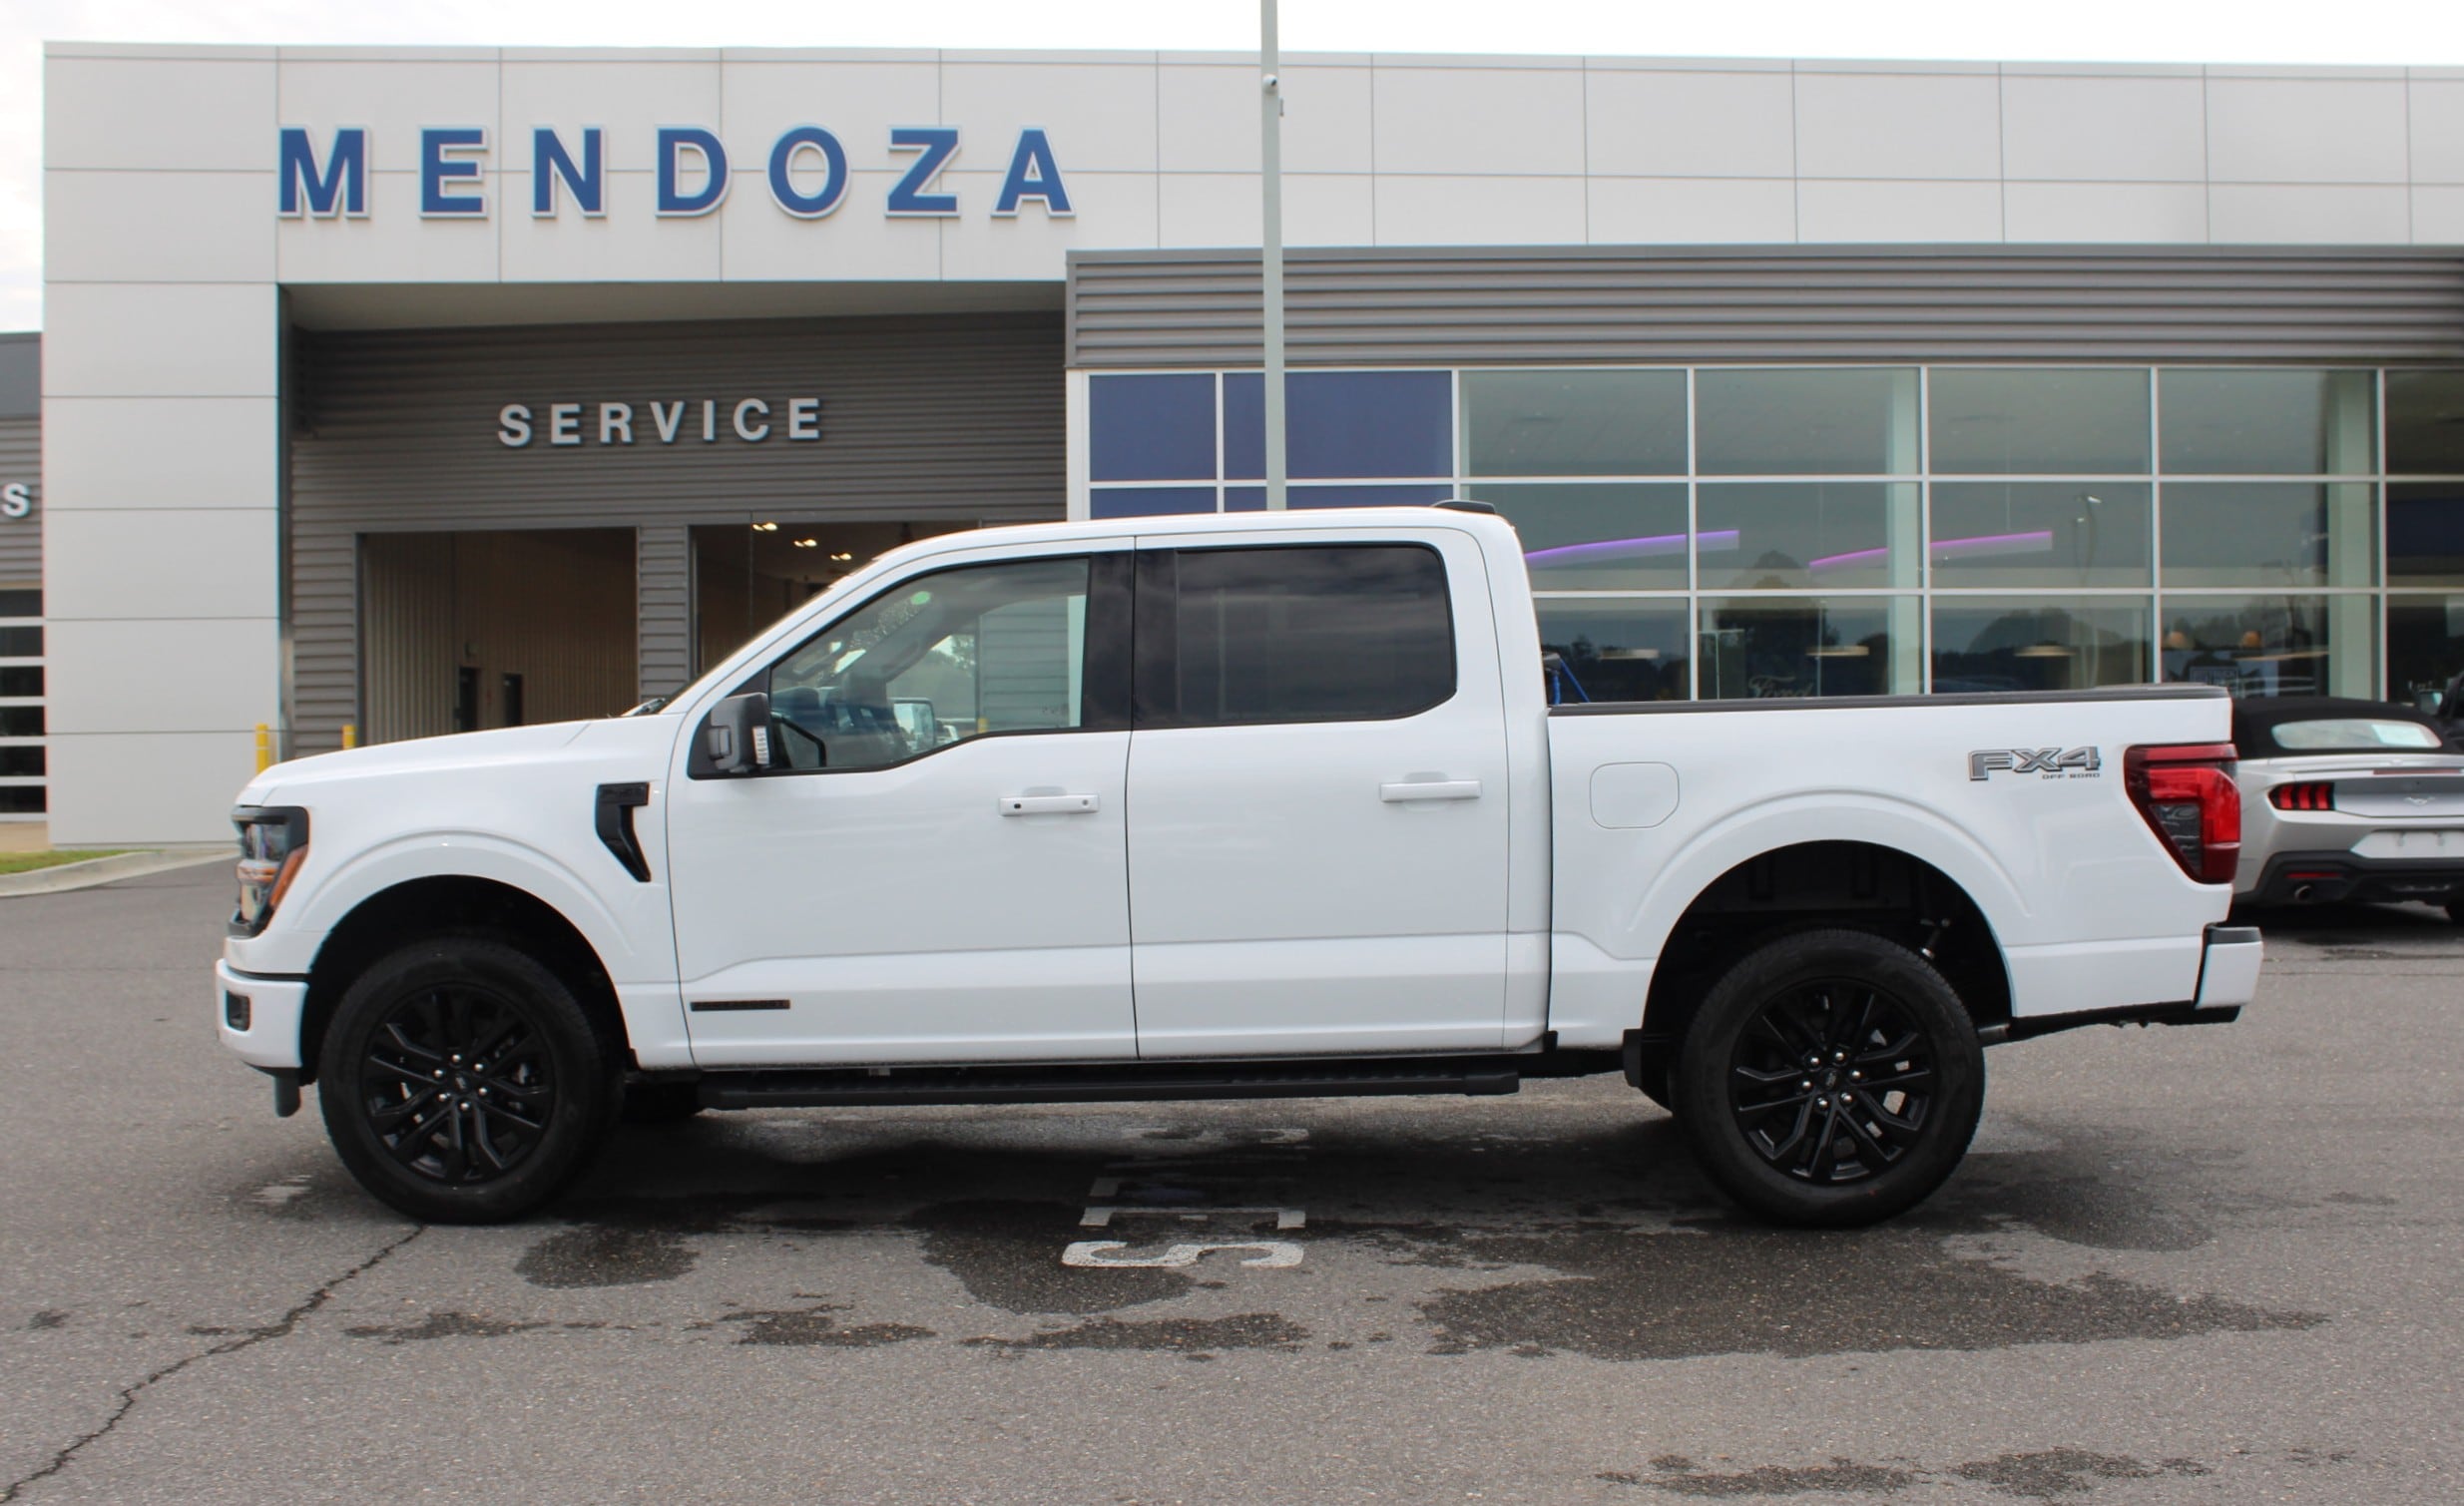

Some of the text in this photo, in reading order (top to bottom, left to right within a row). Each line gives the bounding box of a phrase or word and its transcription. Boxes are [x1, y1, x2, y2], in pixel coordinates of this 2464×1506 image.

[278, 126, 1075, 220] MENDOZA
[498, 398, 820, 447] SERVICE
[2, 483, 31, 518] S
[1968, 747, 2101, 780] FX4
